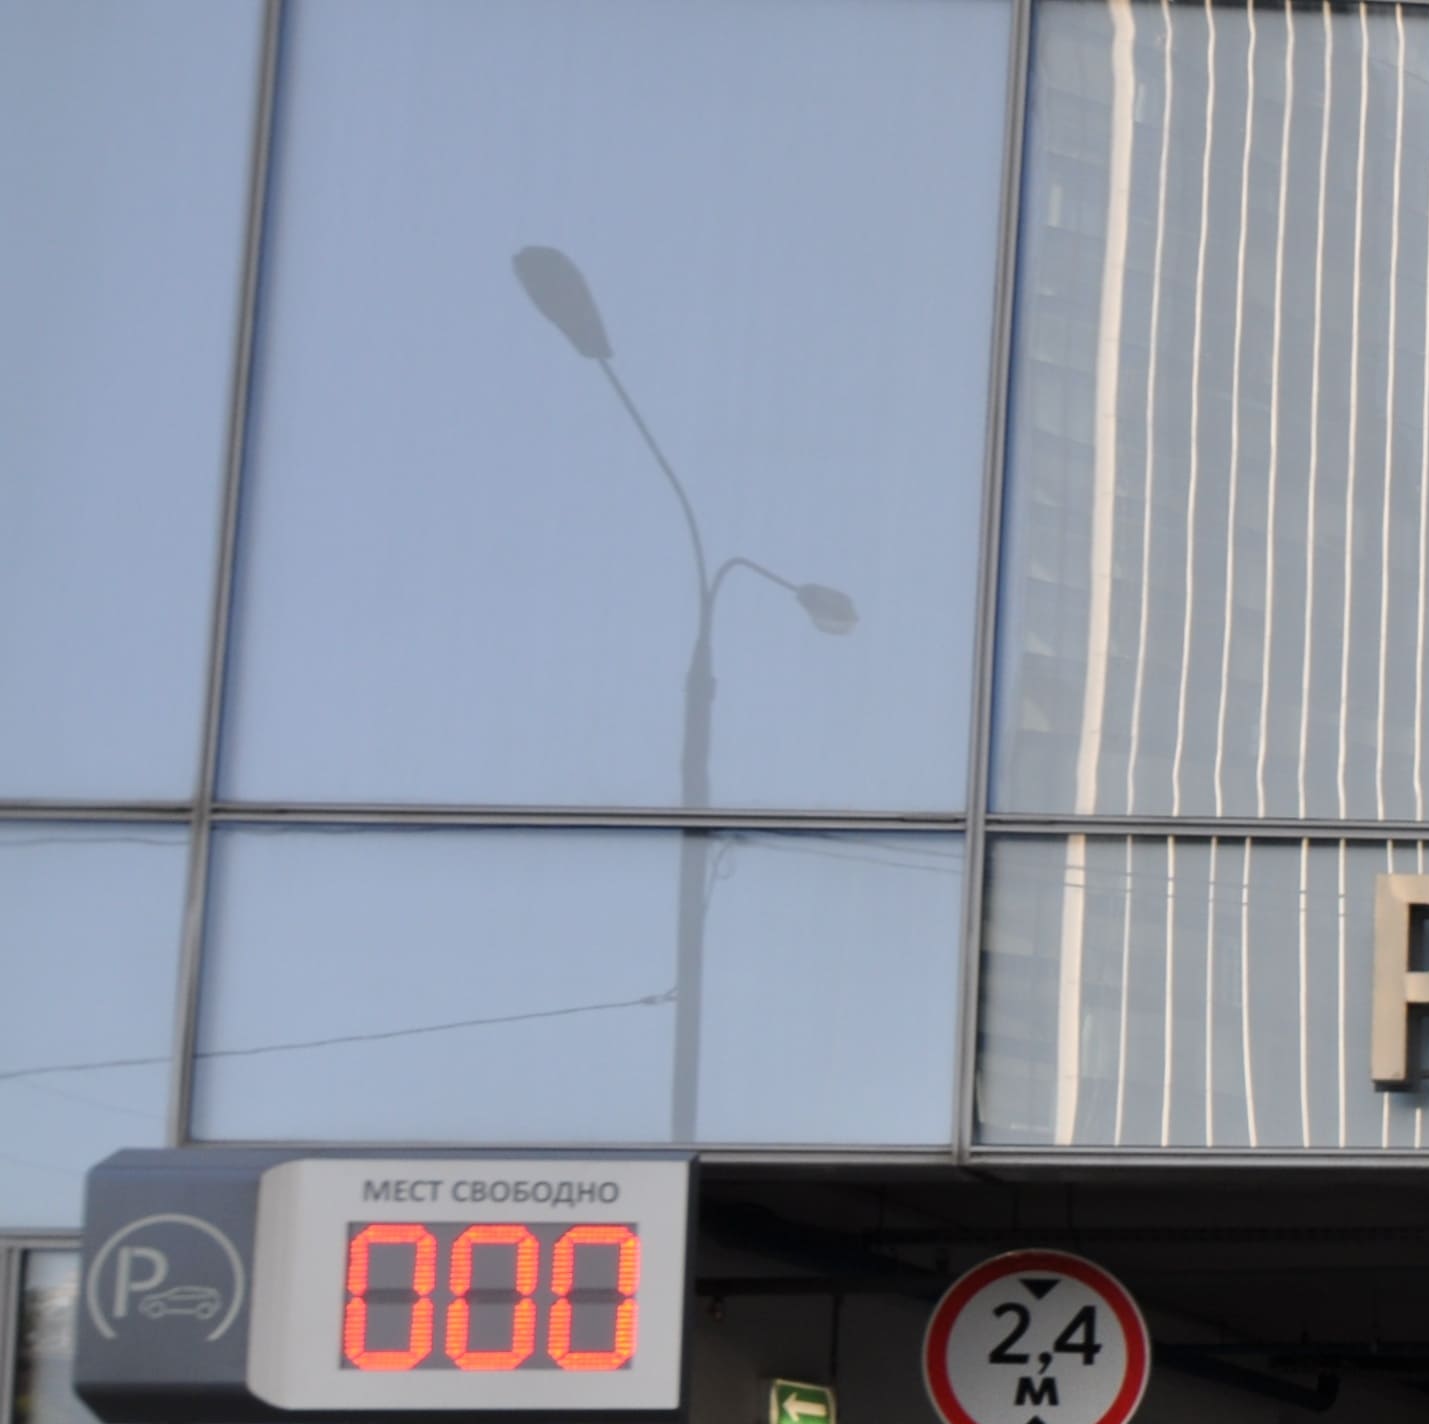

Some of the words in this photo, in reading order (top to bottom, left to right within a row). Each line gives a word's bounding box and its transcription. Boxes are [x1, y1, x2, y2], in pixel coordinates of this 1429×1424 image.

[361, 1178, 443, 1204] МЕСТ
[451, 1179, 620, 1206] СВОБОДНО
[113, 1245, 168, 1319] P
[343, 1222, 641, 1372] 000
[987, 1301, 1102, 1375] 2,4
